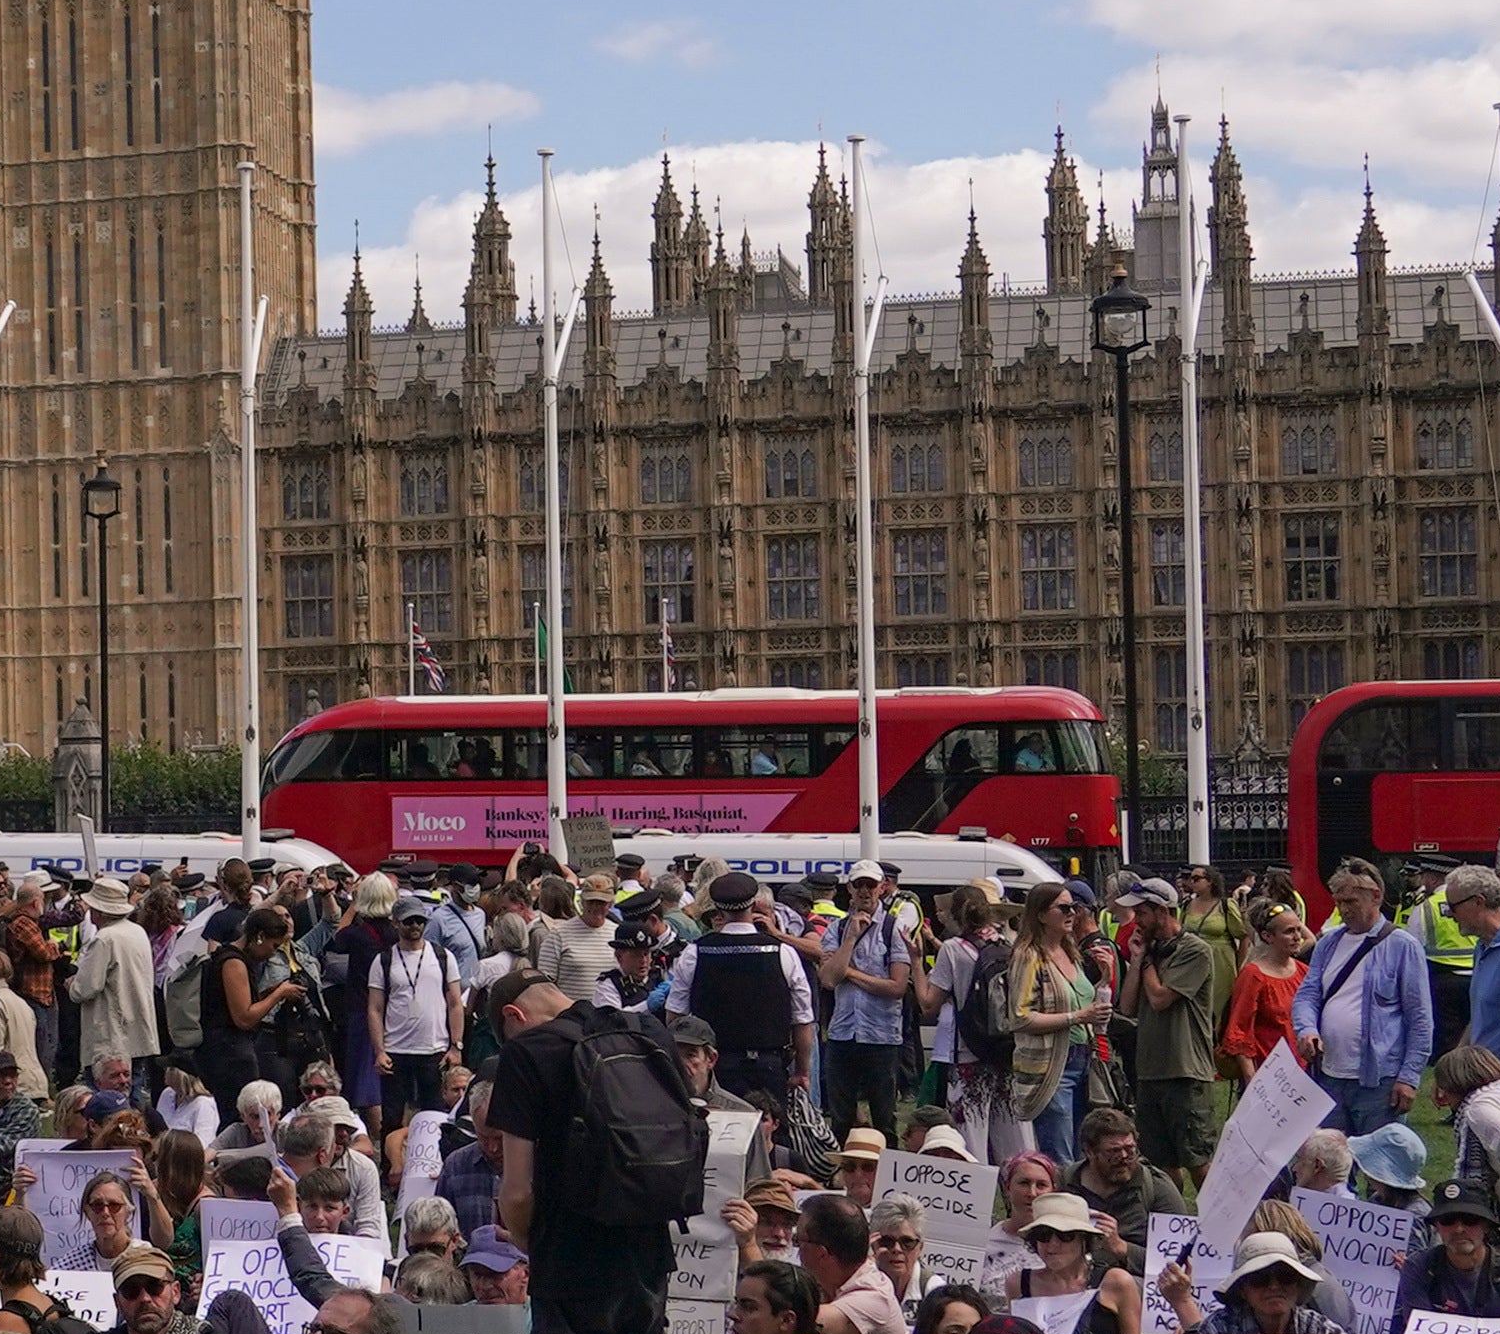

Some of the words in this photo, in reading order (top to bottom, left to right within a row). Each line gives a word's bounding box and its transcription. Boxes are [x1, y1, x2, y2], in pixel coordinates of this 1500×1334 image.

[403, 811, 466, 832] Moco
[485, 808, 546, 823] Banksy,
[612, 808, 670, 821] Haring,
[673, 807, 747, 823] Basquiat,
[485, 827, 550, 839] Kusama,
[1269, 1065, 1306, 1104] OPPOSE
[1250, 1075, 1289, 1125] GENOCIDE
[905, 1165, 971, 1194] OPPOSE
[1317, 1202, 1406, 1243] OPPOSE
